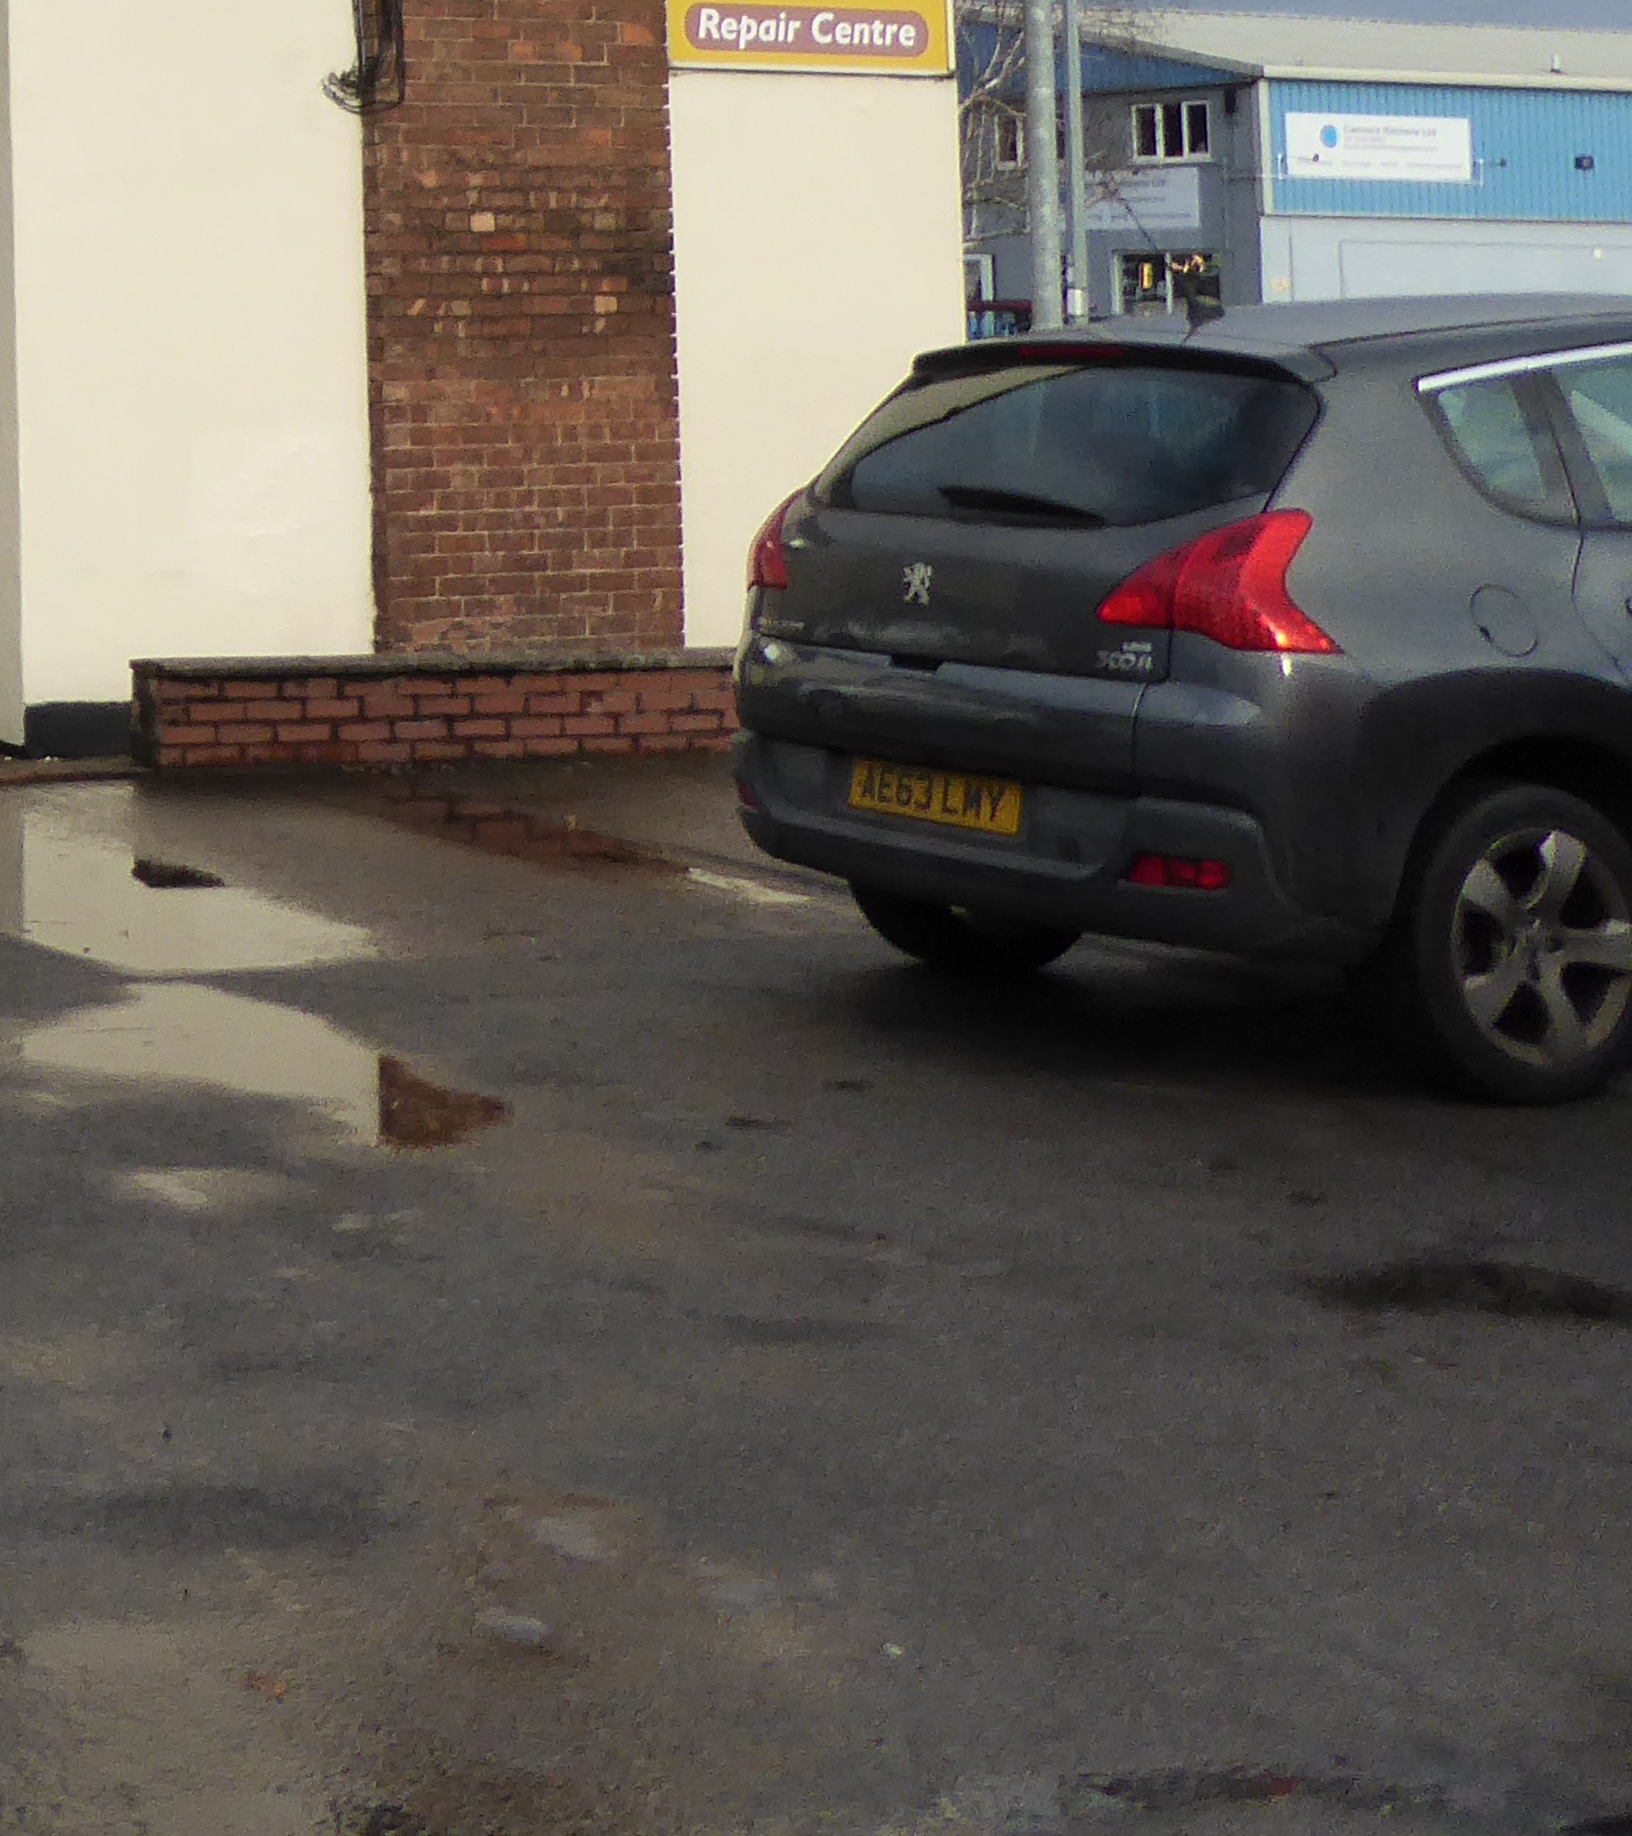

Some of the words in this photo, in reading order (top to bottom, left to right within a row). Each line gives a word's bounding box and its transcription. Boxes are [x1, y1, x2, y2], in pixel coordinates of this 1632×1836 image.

[697, 7, 801, 50] Repair
[811, 11, 917, 47] Centre
[860, 764, 934, 811] AE63
